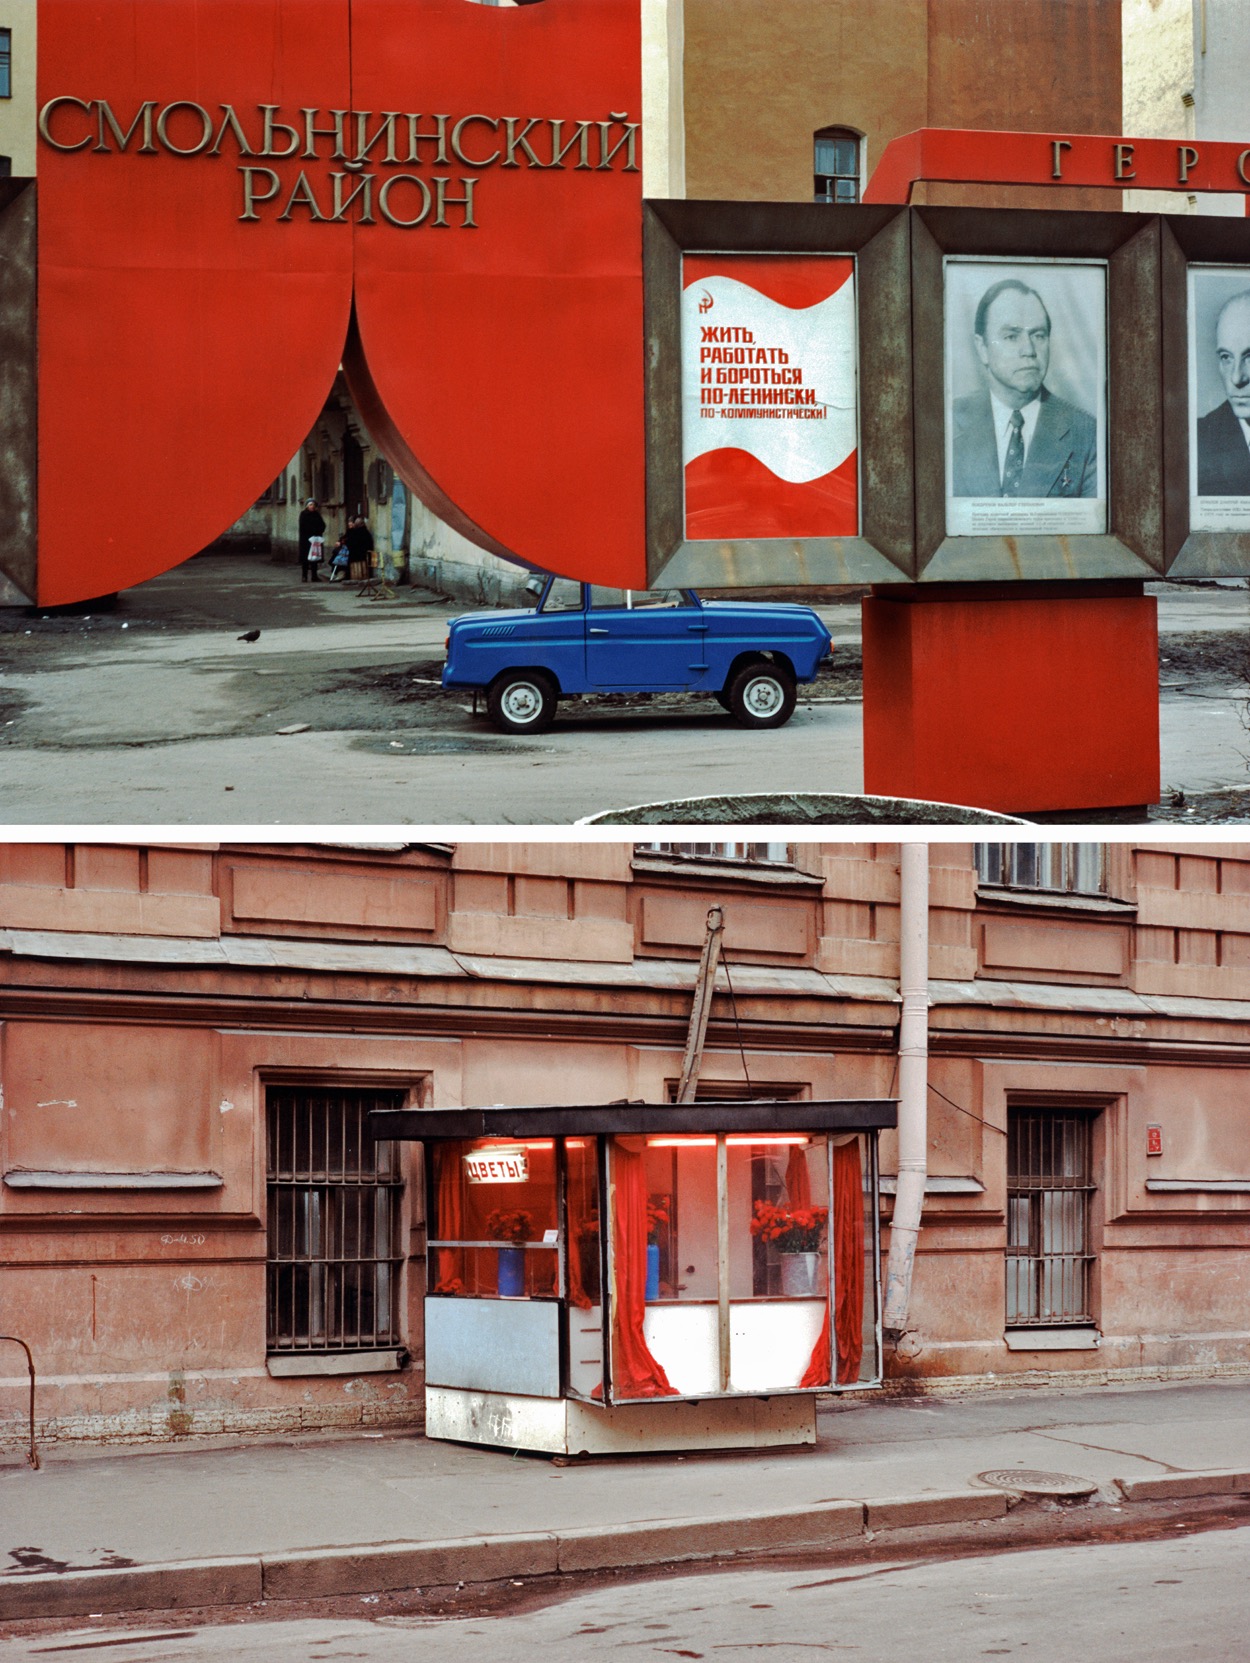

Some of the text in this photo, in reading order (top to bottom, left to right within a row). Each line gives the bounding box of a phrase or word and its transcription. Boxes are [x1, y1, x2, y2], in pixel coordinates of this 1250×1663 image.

[38, 95, 640, 172] СМОЛЬНИНСКИЙ
[237, 161, 479, 228] РАЙОН
[700, 326, 756, 345] ЖИТЬ,
[700, 347, 789, 364] РАБОТАТЬ
[700, 368, 802, 385] И БОРОТЬСЯ
[700, 388, 818, 407] ПО-ЛЕНИНСКИ,
[700, 406, 827, 419] ПО-КОММУНИСТИЧЕСКИ!
[468, 1161, 520, 1181] ЦВЕТЫ
